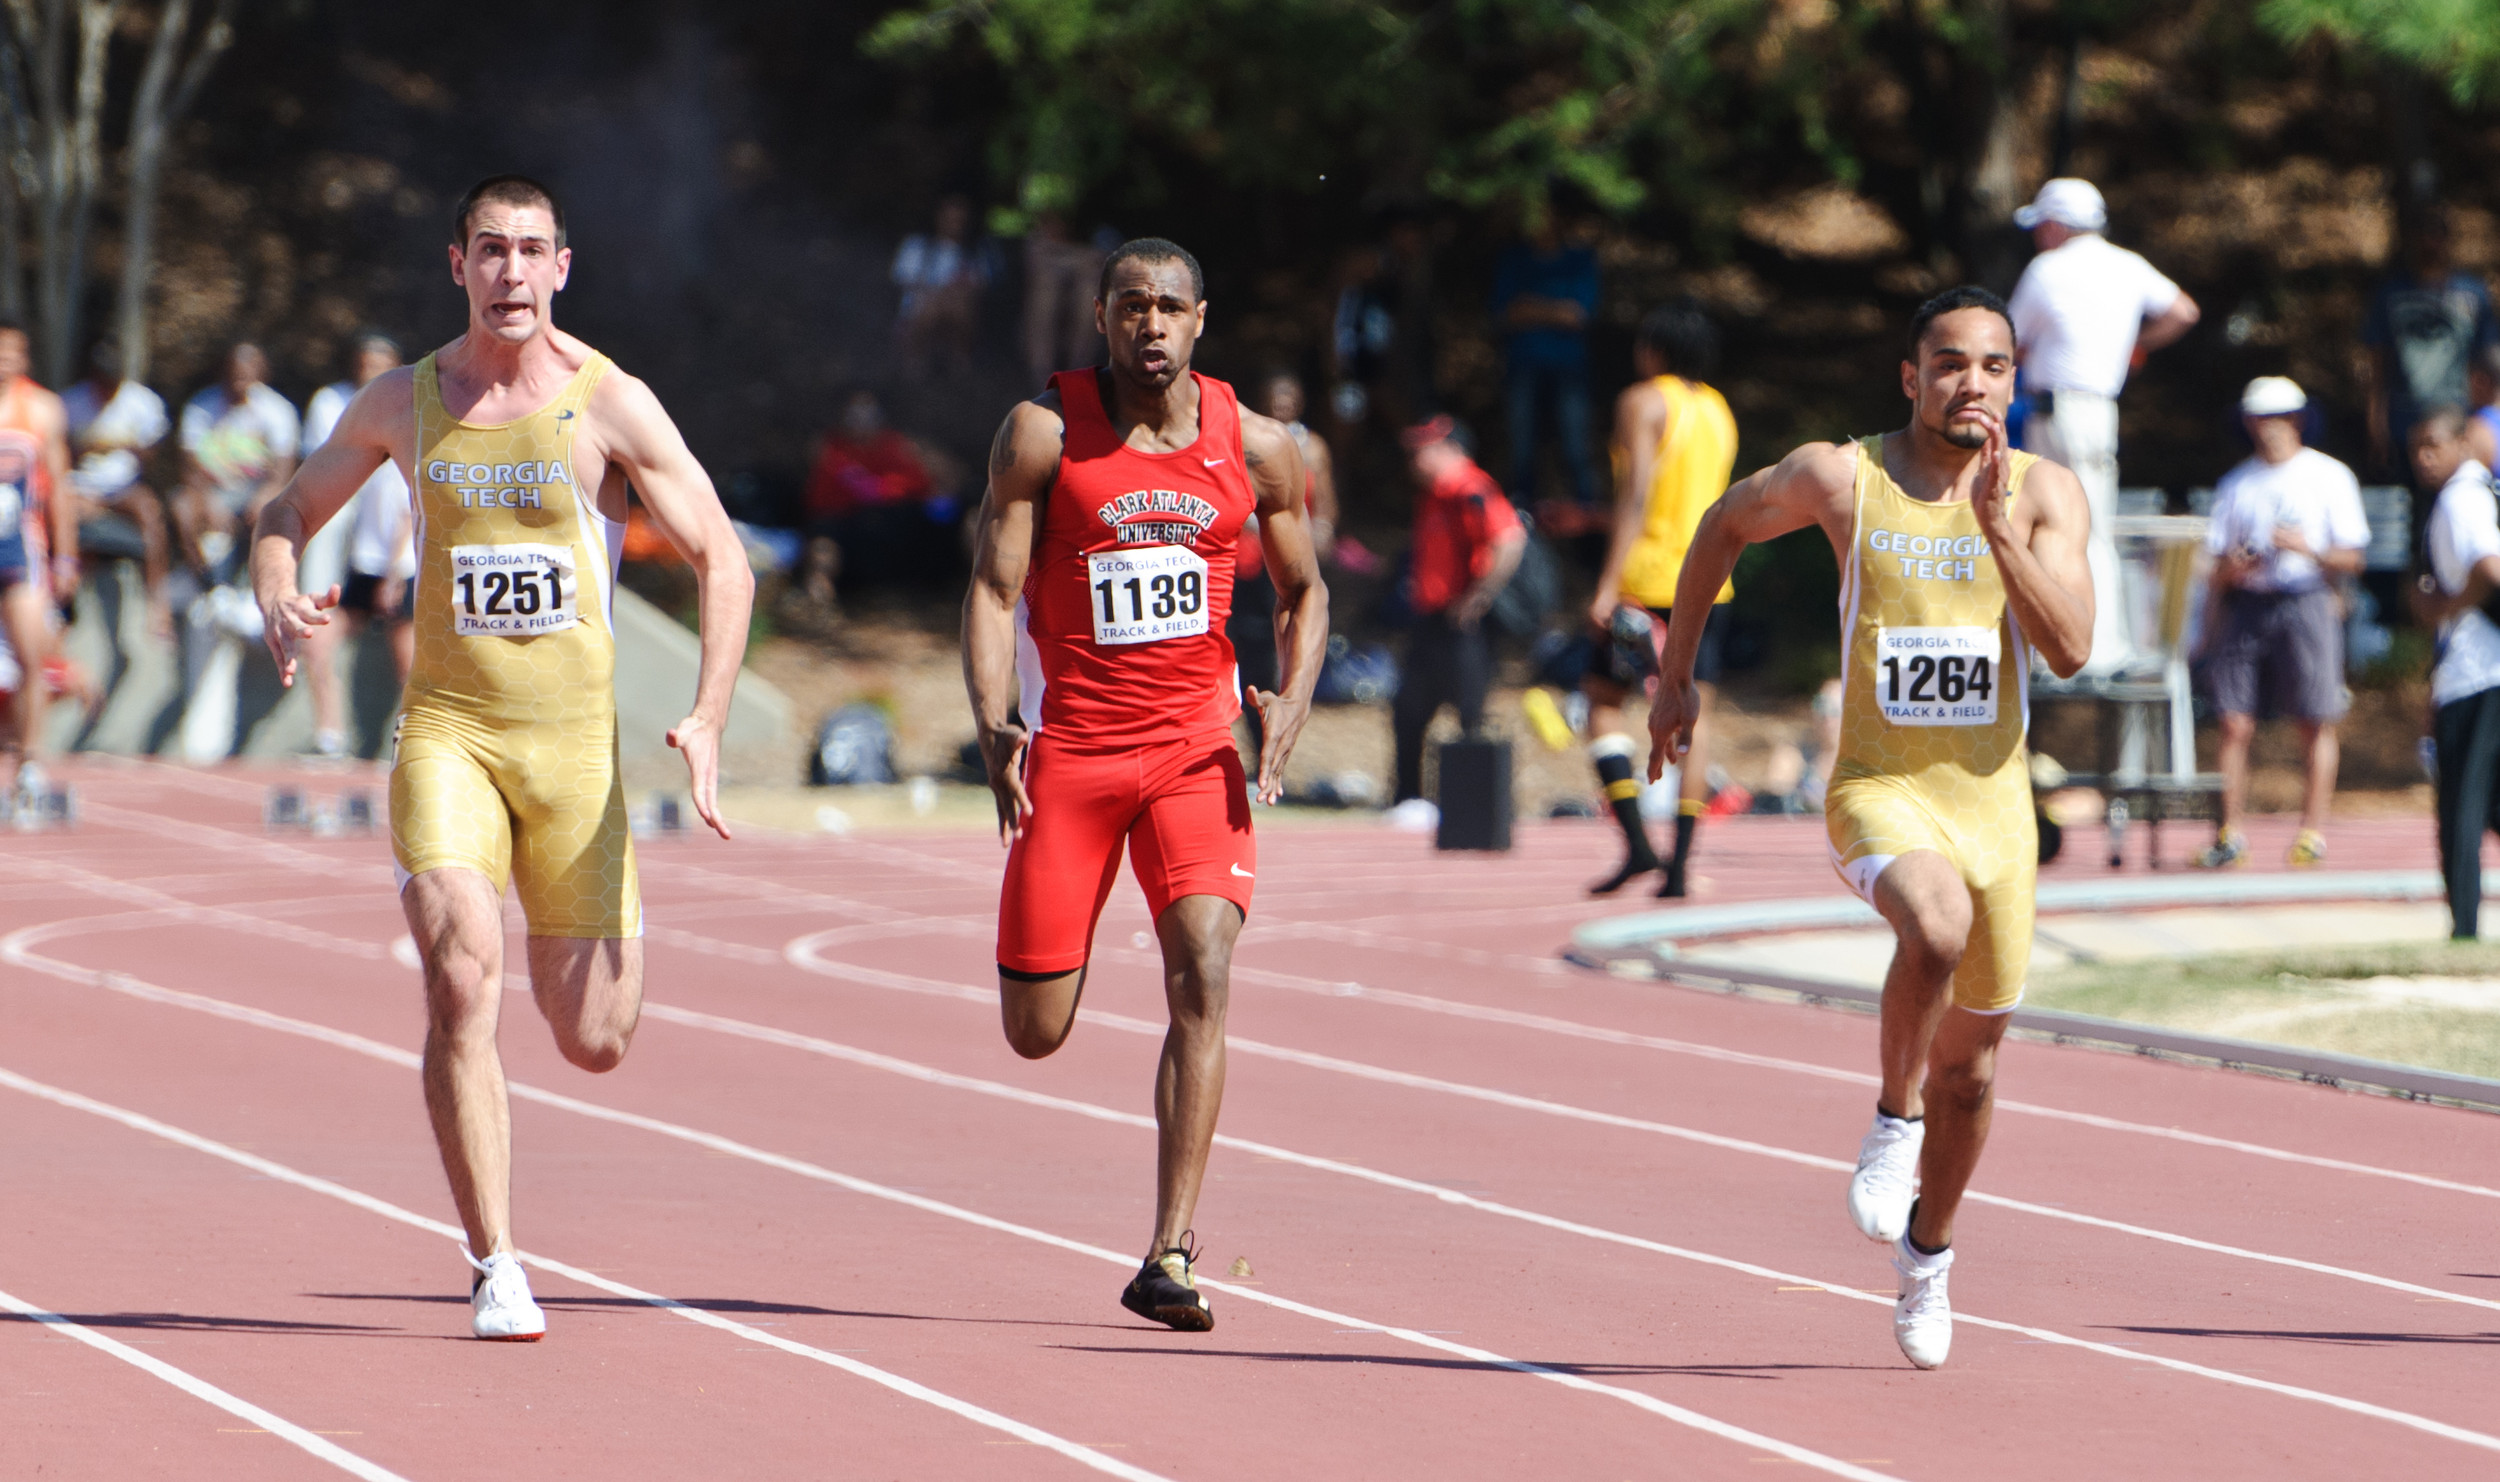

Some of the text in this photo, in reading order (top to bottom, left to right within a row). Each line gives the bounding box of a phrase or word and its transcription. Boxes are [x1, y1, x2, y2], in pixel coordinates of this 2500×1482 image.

[427, 460, 570, 485] GEORGIA
[456, 487, 542, 509] TECH
[1097, 489, 1220, 531] CLARK ATLANTA
[1116, 521, 1202, 546] UNIVERSITY
[458, 555, 523, 566] GEORGIA
[1096, 556, 1197, 572] GEORGIA TECH
[1898, 557, 1975, 581] TECH
[457, 567, 562, 615] 1251
[1095, 570, 1202, 623] 1139
[463, 614, 564, 630] TRACK & FIELD
[1102, 618, 1199, 638] TRACK & FIELD
[1886, 637, 1951, 648] GEORGIA
[1882, 655, 1992, 702] 1264
[1884, 705, 1986, 717] TRACK & FIELD
